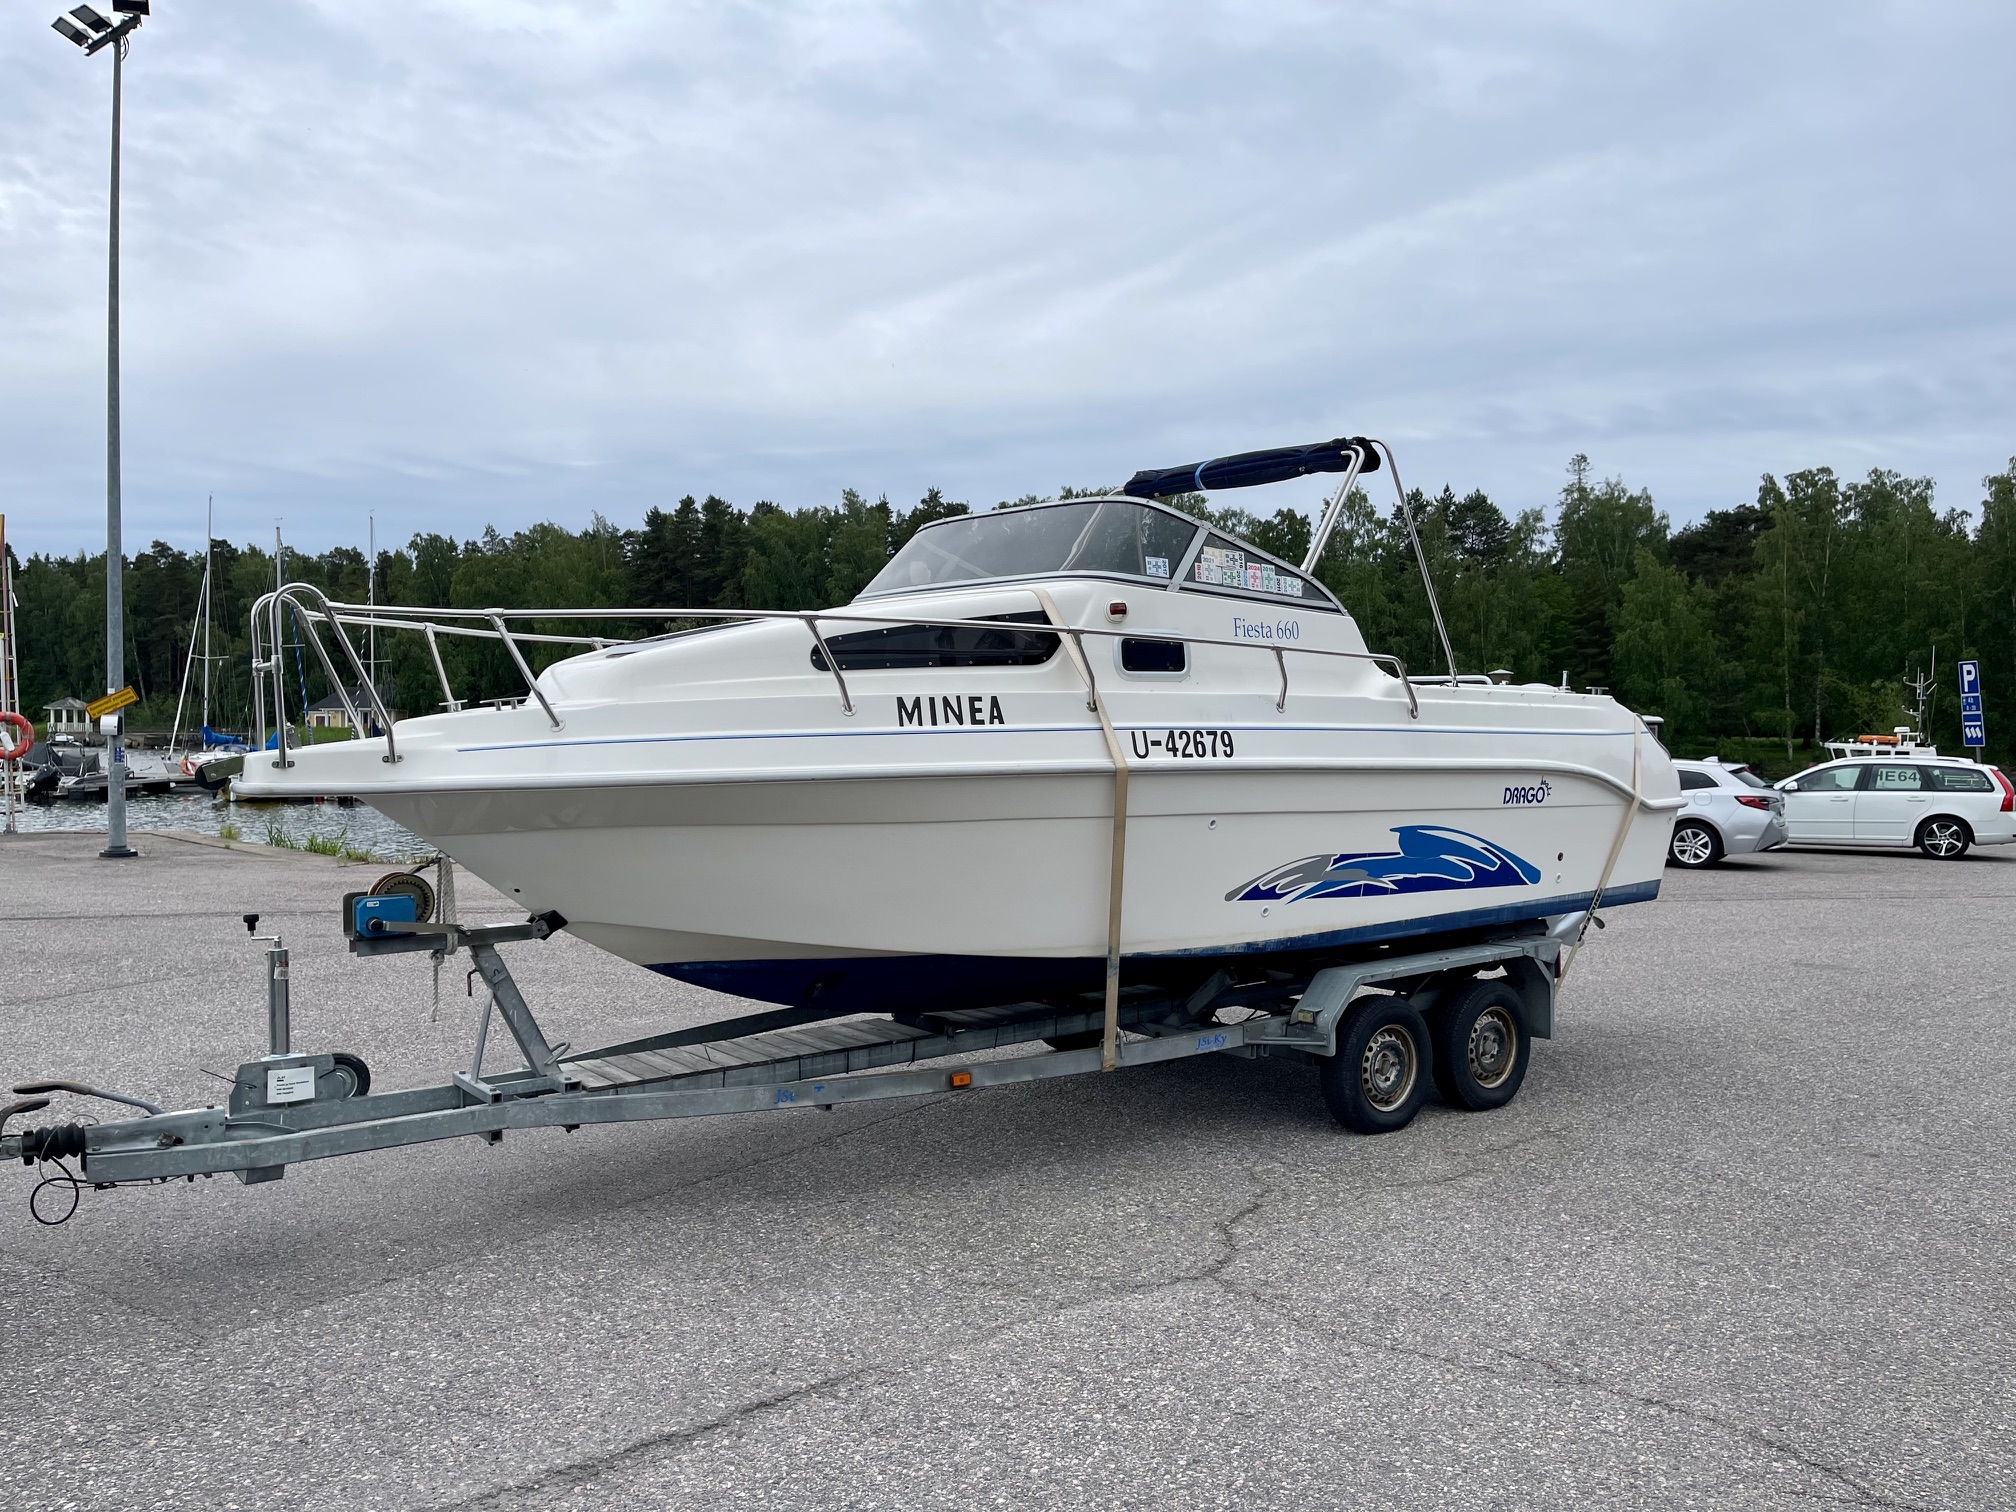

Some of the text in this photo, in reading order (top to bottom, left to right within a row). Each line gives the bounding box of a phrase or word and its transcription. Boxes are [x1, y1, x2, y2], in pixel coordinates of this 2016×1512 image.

[1233, 617, 1299, 640] Fiesta 660
[1962, 664, 1976, 692] P
[896, 695, 1005, 727] MINEA
[1131, 730, 1234, 759] U-42679
[1503, 786, 1545, 804] DRAGO
